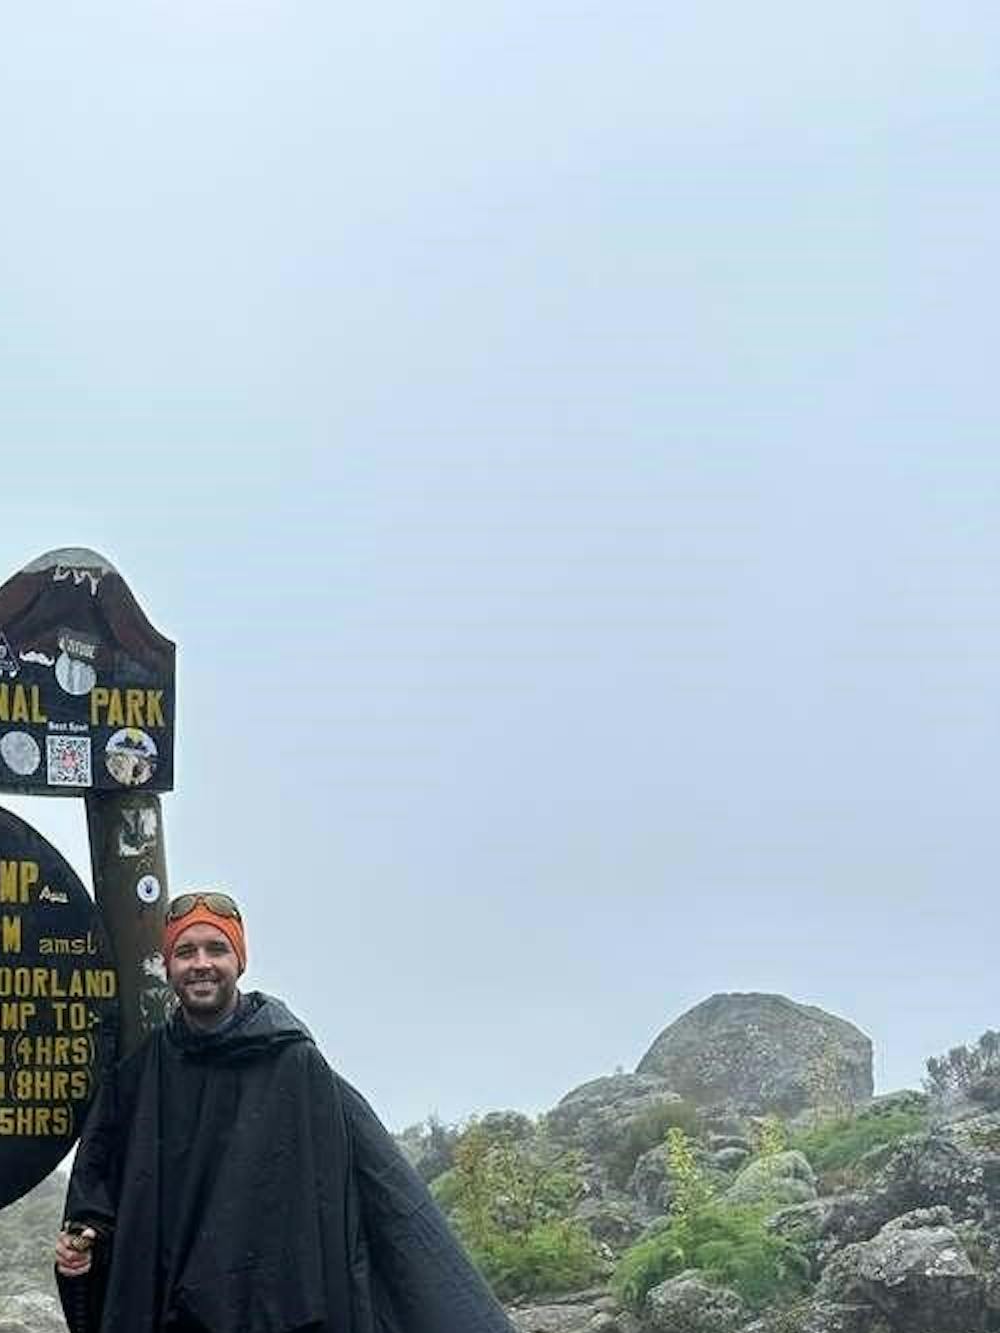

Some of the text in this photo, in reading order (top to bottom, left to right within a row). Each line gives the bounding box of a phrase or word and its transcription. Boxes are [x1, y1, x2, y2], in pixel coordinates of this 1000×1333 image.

[90, 688, 165, 728] PARK
[1, 916, 22, 953] M
[39, 931, 98, 955] amsl
